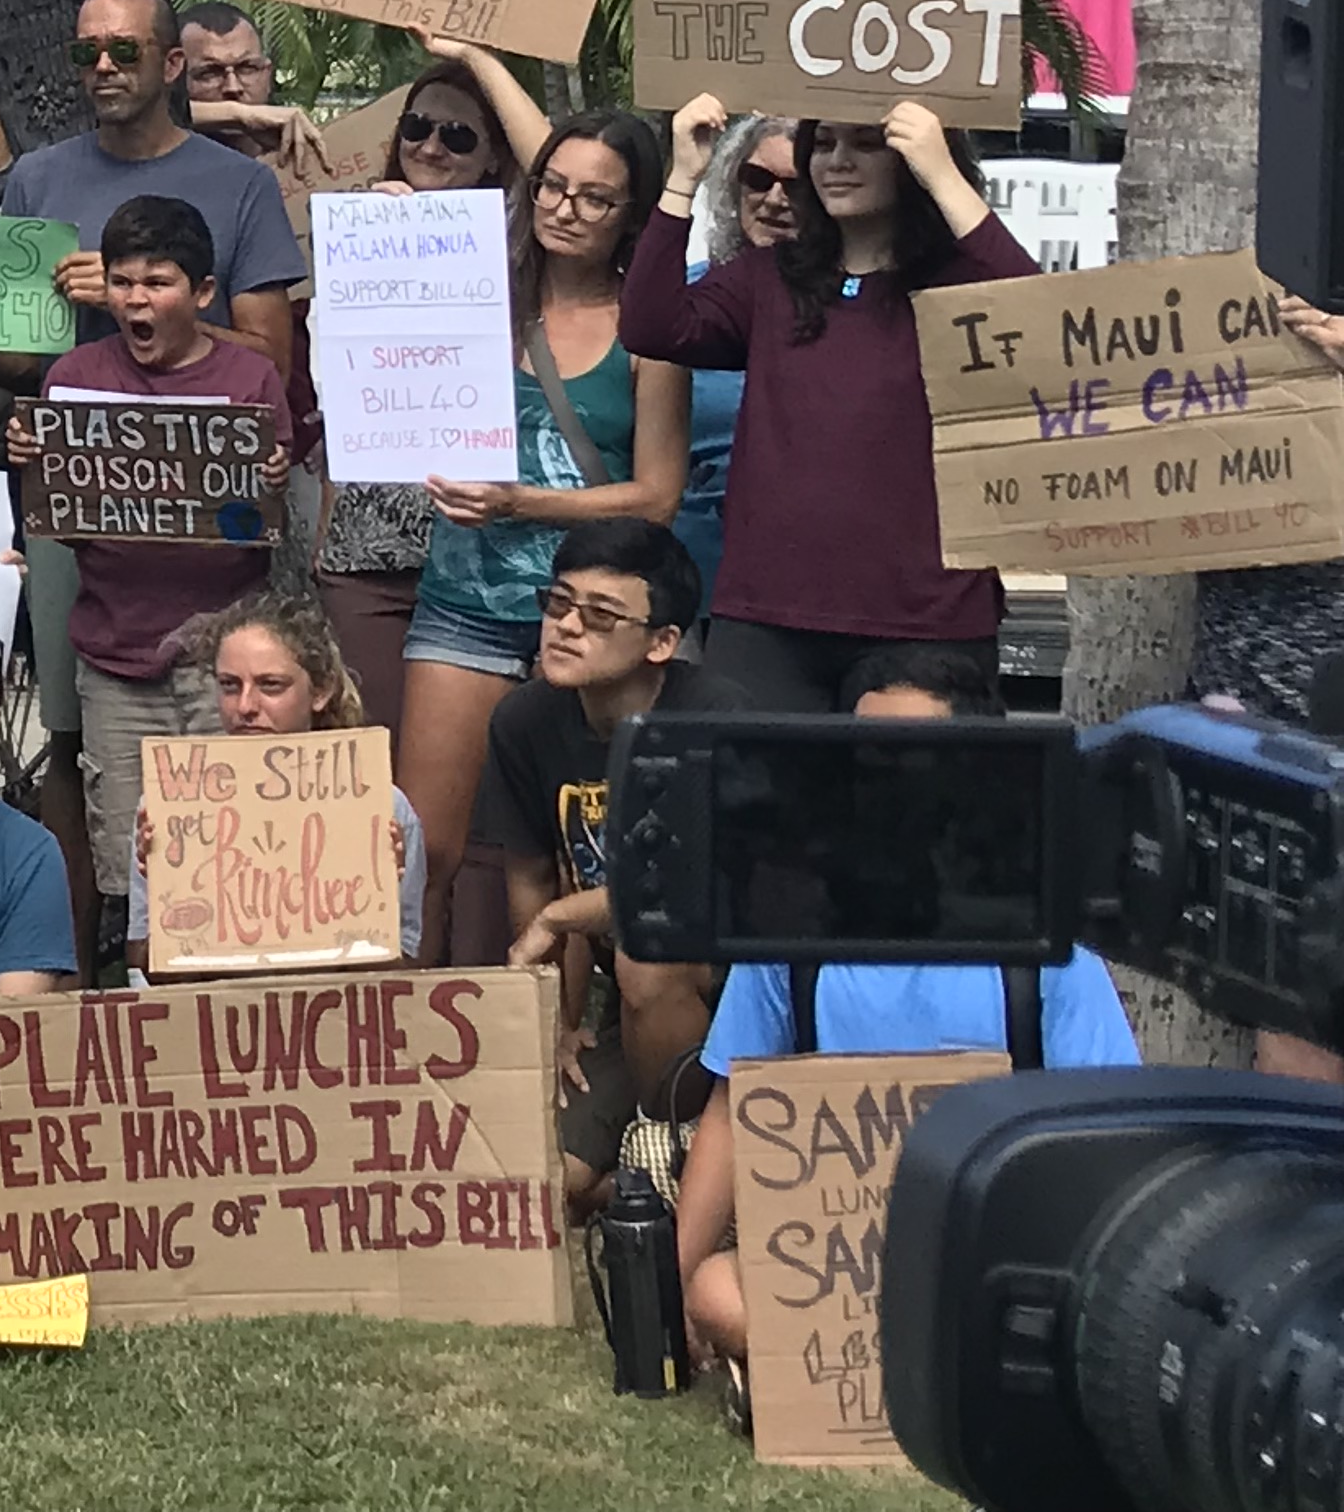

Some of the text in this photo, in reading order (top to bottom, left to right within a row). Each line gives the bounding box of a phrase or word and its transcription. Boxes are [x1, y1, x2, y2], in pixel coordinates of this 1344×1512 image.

[654, 1, 769, 64] THE
[416, 230, 478, 259] HONUA
[329, 278, 494, 304] SUPPORT BILL 40
[12, 291, 72, 343] 40
[346, 346, 464, 370] I SUPPORT
[953, 312, 1023, 374] IF
[362, 384, 478, 414] BILL 40
[1029, 357, 1248, 439] WE CAN
[33, 407, 260, 456] PLASTICS
[342, 429, 422, 454] BECAUSE
[42, 452, 186, 492] POISON
[984, 477, 1018, 505] NO
[1042, 465, 1130, 501] FOAM
[1154, 458, 1198, 495] ON
[49, 493, 202, 534] PLANET
[1044, 520, 1158, 552] SUPPORT
[1274, 502, 1309, 529] 40
[152, 739, 370, 802] We Still
[165, 811, 216, 868] get
[196, 978, 484, 1099] LUNCHES
[121, 1102, 317, 1182] HARMED
[350, 1099, 471, 1173] IN
[212, 1194, 267, 1237] OF
[278, 1181, 446, 1253] THIS
[457, 1180, 562, 1250] BILL
[821, 1185, 890, 1217] LUN
